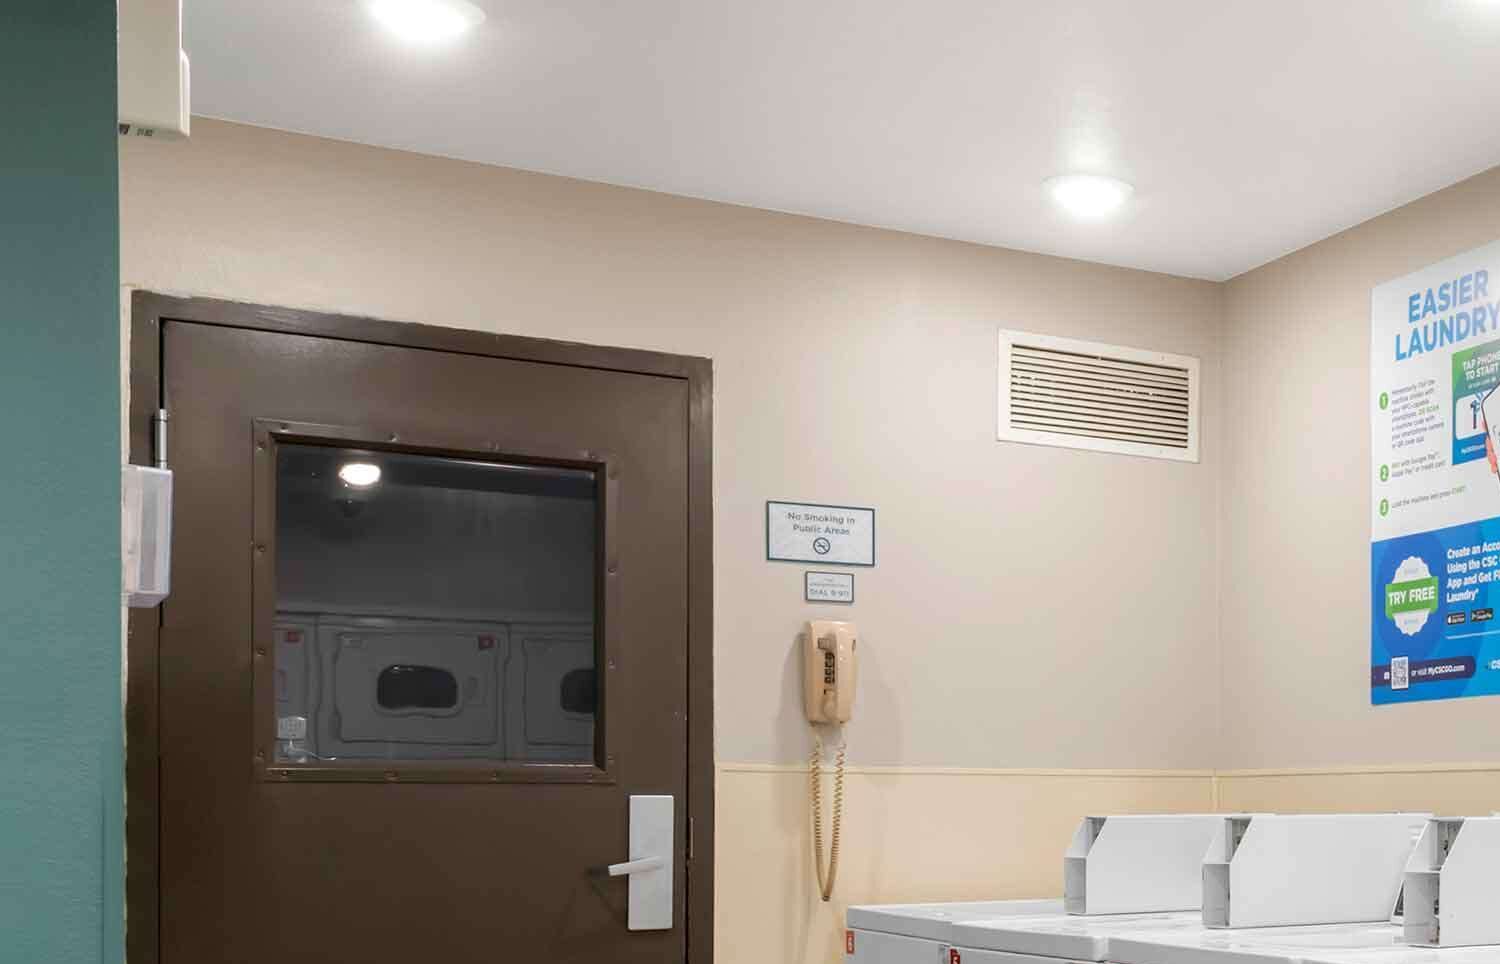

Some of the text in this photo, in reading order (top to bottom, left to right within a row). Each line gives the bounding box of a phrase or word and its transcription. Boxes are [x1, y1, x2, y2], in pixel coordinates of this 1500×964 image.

[1408, 269, 1489, 323] EASIER
[1462, 359, 1476, 372] TAP
[1465, 363, 1499, 380] TO START
[787, 512, 801, 520] No
[804, 513, 844, 525] Smoking
[793, 523, 850, 535] Public Areas
[1447, 544, 1471, 559] Create
[1472, 543, 1481, 555] an
[1447, 561, 1468, 574] Using
[1468, 557, 1480, 570] the
[1482, 555, 1498, 568] CSC
[1447, 575, 1462, 590] App
[1463, 573, 1477, 586] and
[1478, 570, 1492, 584] Get
[1388, 586, 1435, 606] TRY FREE
